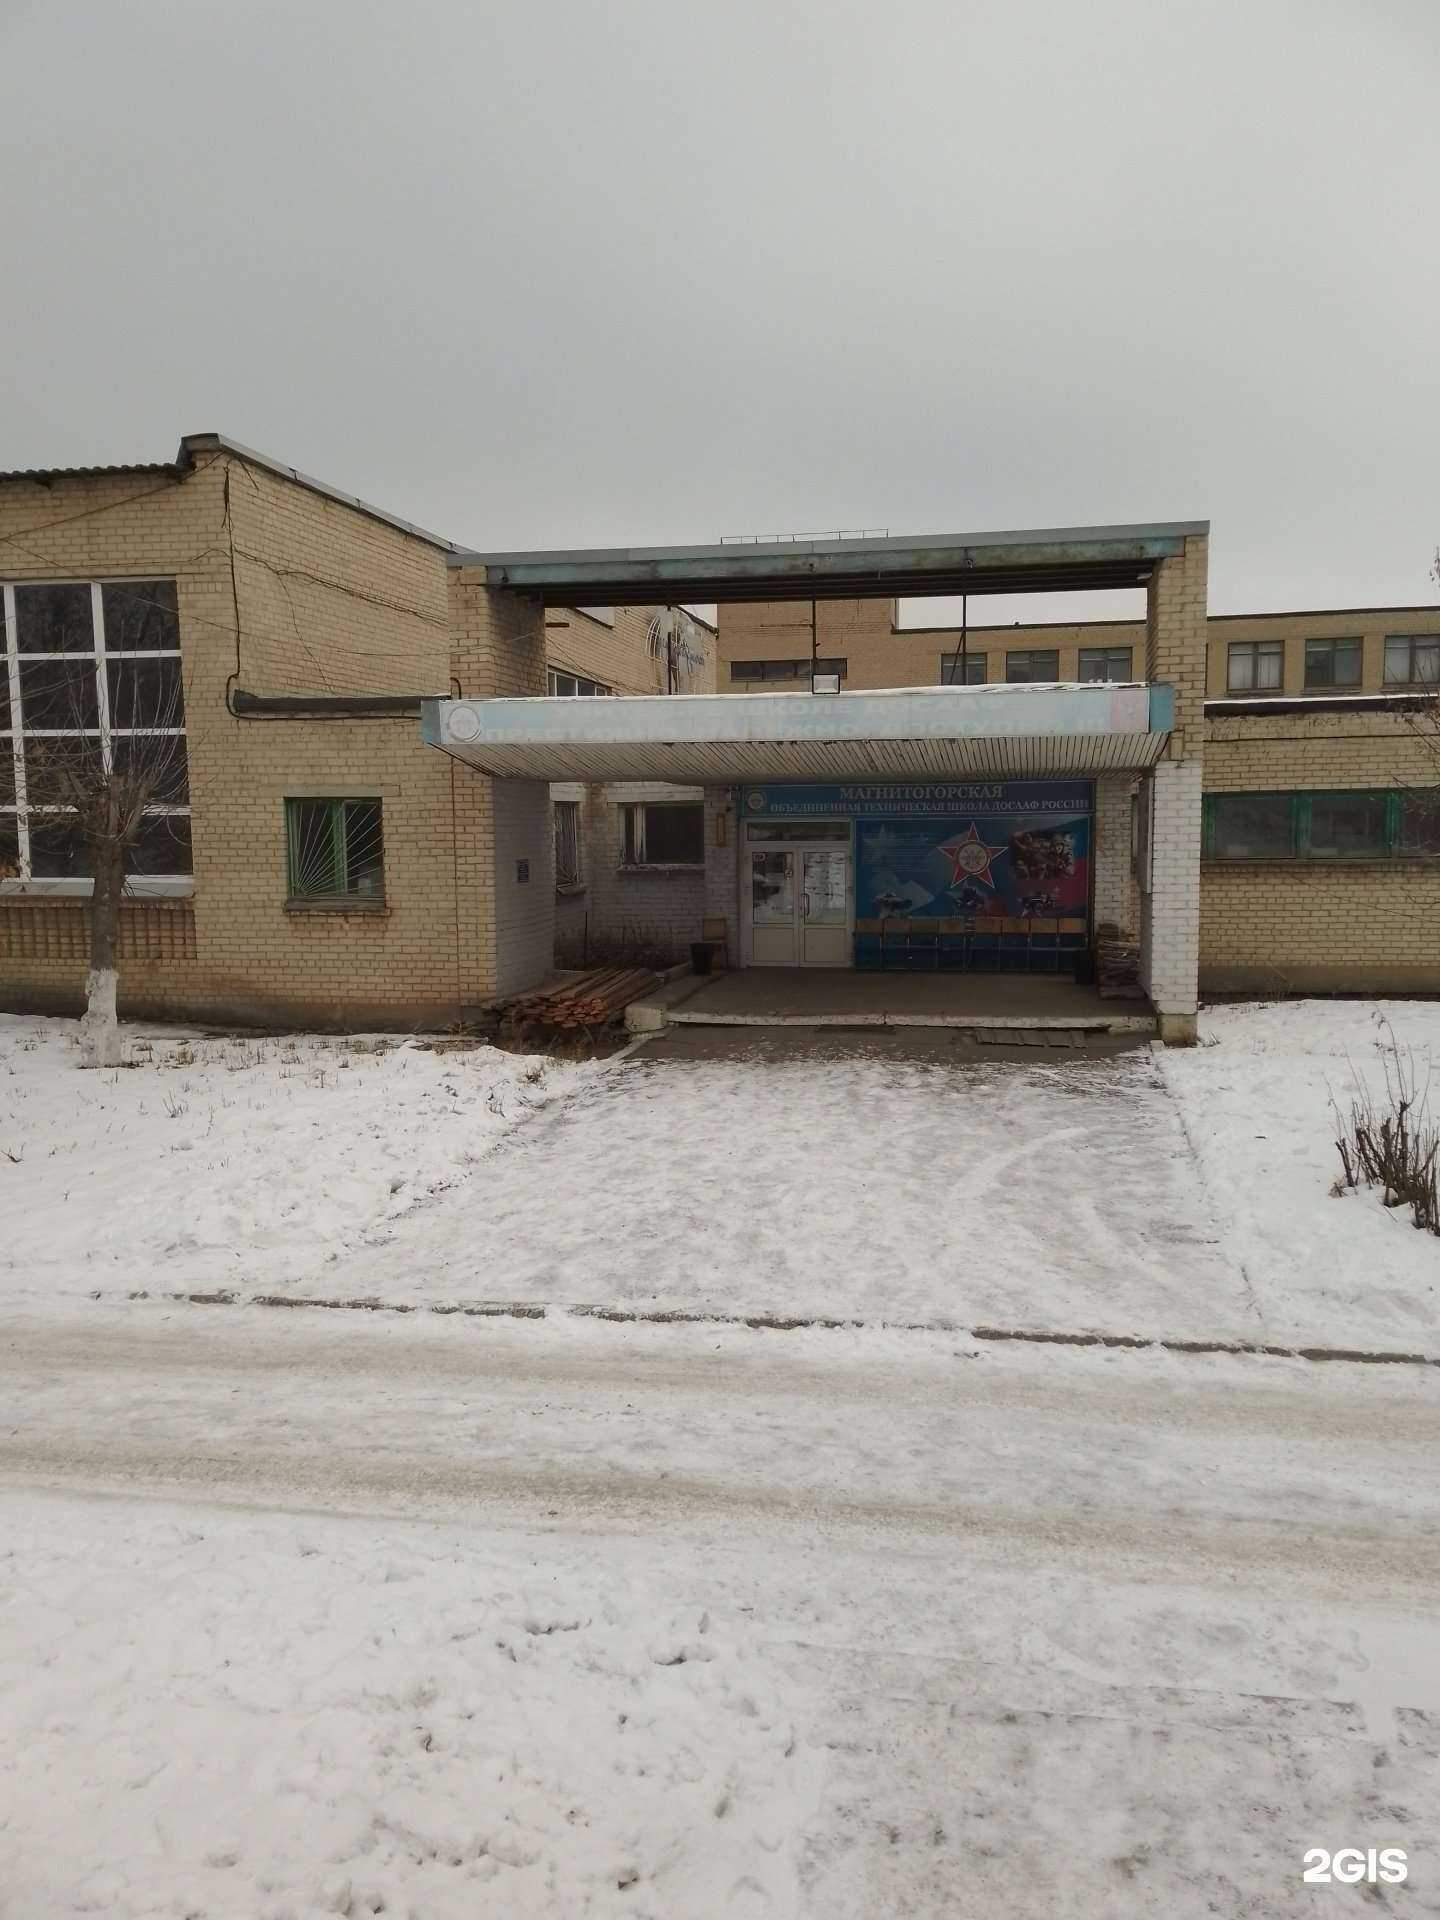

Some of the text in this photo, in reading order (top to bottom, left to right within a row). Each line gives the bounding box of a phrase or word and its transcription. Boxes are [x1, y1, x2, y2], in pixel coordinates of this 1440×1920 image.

[738, 699, 854, 716] ШКОЛЕ
[864, 696, 1005, 715] ДОСААФ
[839, 785, 1004, 800] МАГНИТОГОРСКАЯ
[863, 801, 944, 812] ТЕХНИЧЕСКАЯ
[947, 800, 990, 812] ШКОЛА
[995, 799, 1039, 811] ДОСААФ
[1042, 798, 1089, 810] РОССИИ
